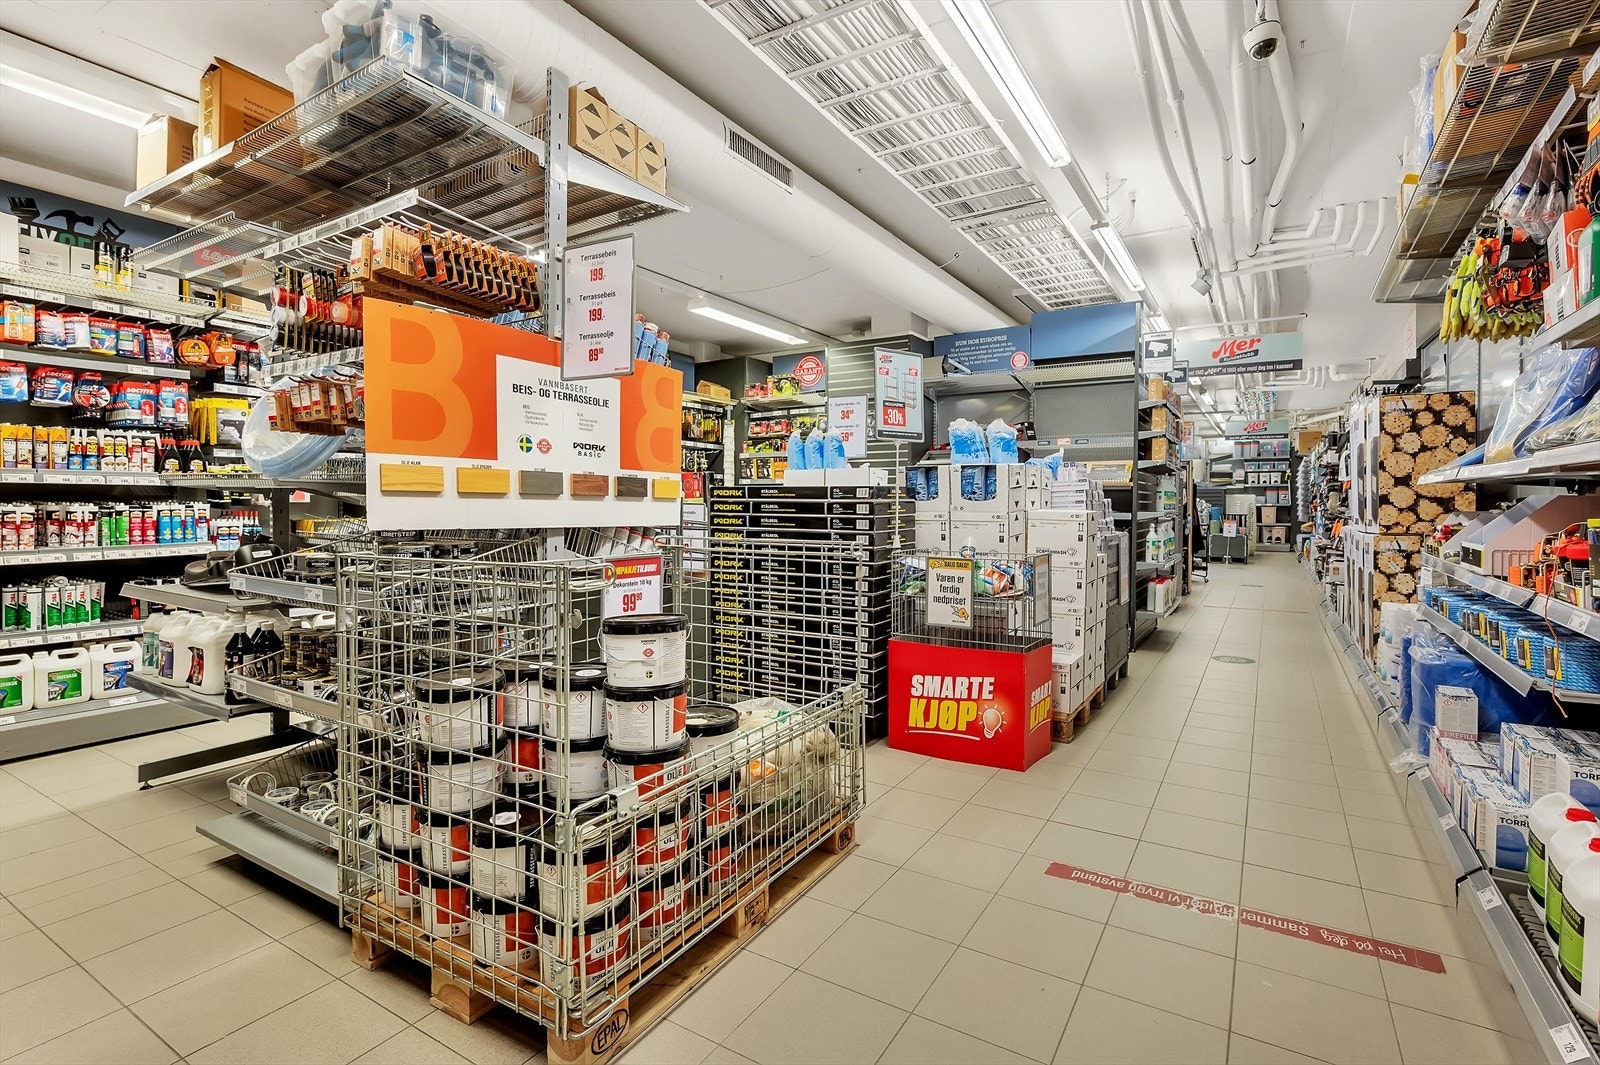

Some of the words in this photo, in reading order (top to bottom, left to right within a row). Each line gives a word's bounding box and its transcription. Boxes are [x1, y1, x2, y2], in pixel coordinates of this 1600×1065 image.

[580, 249, 617, 262] Terrassebeis
[589, 267, 607, 282] 199.-
[579, 290, 616, 302] Terrassebeis
[588, 307, 606, 322] 199.-
[90, 320, 117, 329] LOCTITE
[579, 330, 614, 341] Terrasseolje
[1211, 336, 1262, 359] Mer
[46, 371, 73, 379] LOCTITE
[794, 367, 826, 376] GARANTI
[1204, 367, 1222, 375] Mer
[537, 377, 588, 394] VANNBASERT
[512, 383, 537, 396] BEIS-
[538, 388, 551, 399] OG
[552, 390, 610, 409] TERRASSEOLJE
[884, 409, 904, 425] -30%
[1243, 421, 1269, 433] Mer
[573, 442, 606, 452] WORK
[943, 560, 956, 568] SALG
[714, 573, 744, 581] WORK
[935, 572, 956, 583] Varen
[957, 575, 965, 583] er
[612, 580, 639, 589] Dekorstein
[939, 584, 960, 595] ferdig
[933, 595, 966, 606] nedpriset
[715, 615, 744, 623] WORK
[715, 629, 744, 637] WORK
[910, 674, 995, 700] SMARTE
[1030, 680, 1052, 708] SMART
[907, 697, 978, 732] KJØP
[1448, 733, 1475, 741] REFILL
[1070, 868, 1125, 891] avstand
[1127, 880, 1166, 902] trygg
[1166, 892, 1181, 905] vi
[1318, 927, 1351, 947] deg
[1353, 937, 1375, 953] på
[1377, 944, 1408, 963] Hei
[597, 1015, 625, 1050] EPAL
